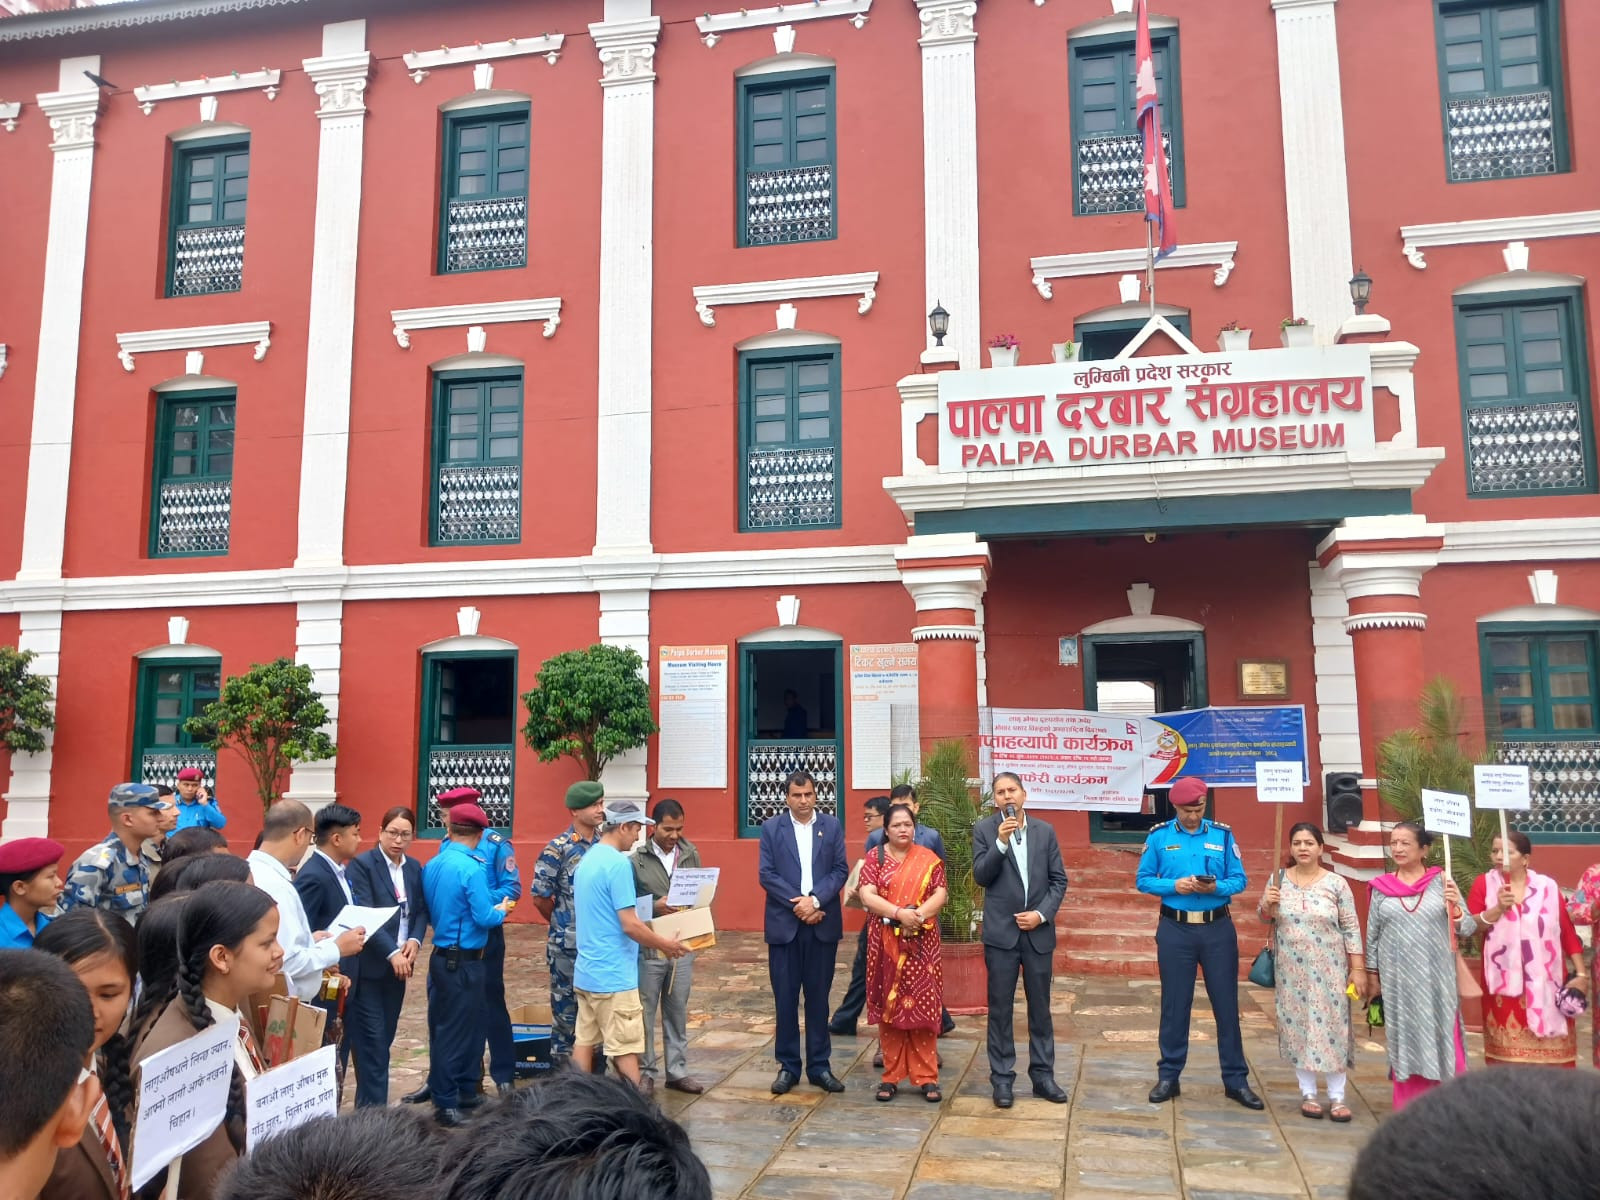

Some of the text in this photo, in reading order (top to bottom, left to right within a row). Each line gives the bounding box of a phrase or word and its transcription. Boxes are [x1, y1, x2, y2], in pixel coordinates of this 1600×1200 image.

[1074, 362, 1233, 388] लुम्बिनी प्रदेश सरकार
[947, 376, 1366, 438] पाल्पा दरबार संग्रहालय
[961, 423, 1346, 467] PALPA DURBAR MUSEUM
[1063, 733, 1133, 752] कार्यक्रम
[1054, 773, 1108, 785] कार्यक्रम
